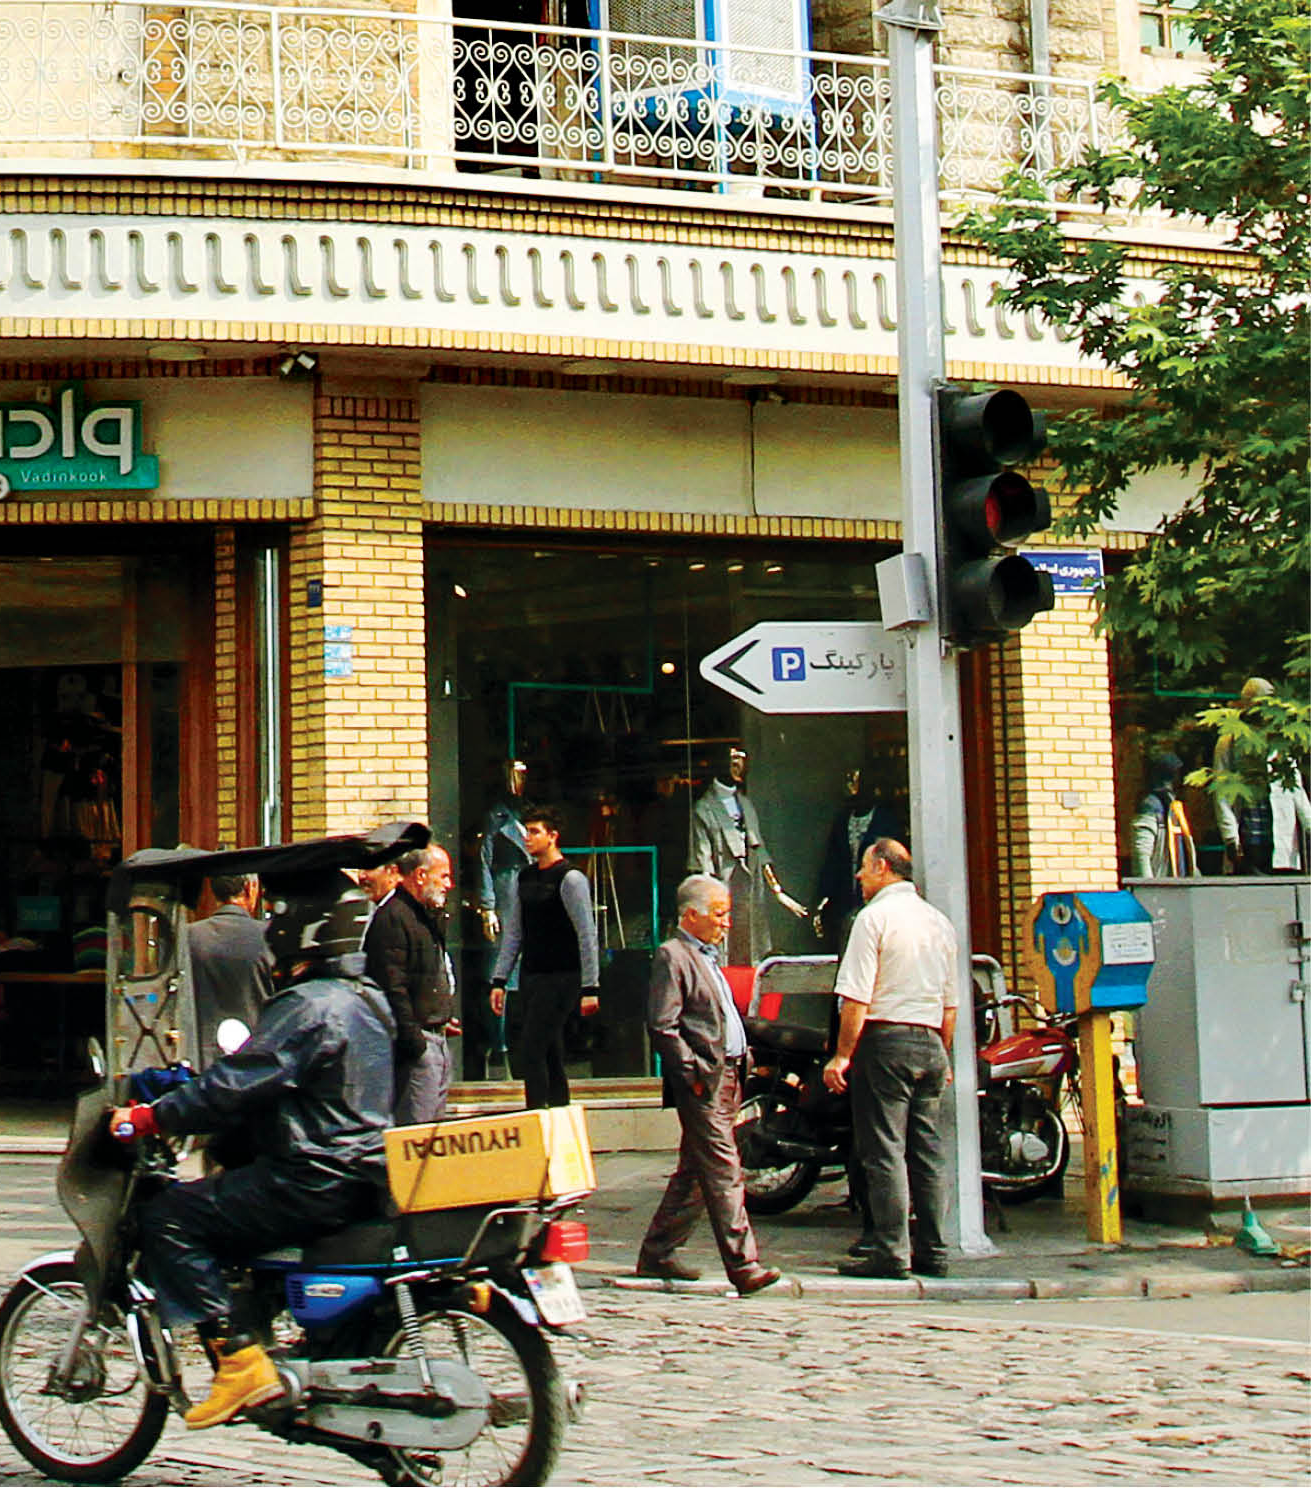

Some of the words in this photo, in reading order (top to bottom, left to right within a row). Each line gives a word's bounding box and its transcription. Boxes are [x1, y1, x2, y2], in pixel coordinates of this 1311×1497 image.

[20, 468, 107, 483] Vadinkook
[809, 650, 896, 680] پارکینگ
[403, 1126, 521, 1161] HYUNDAI
